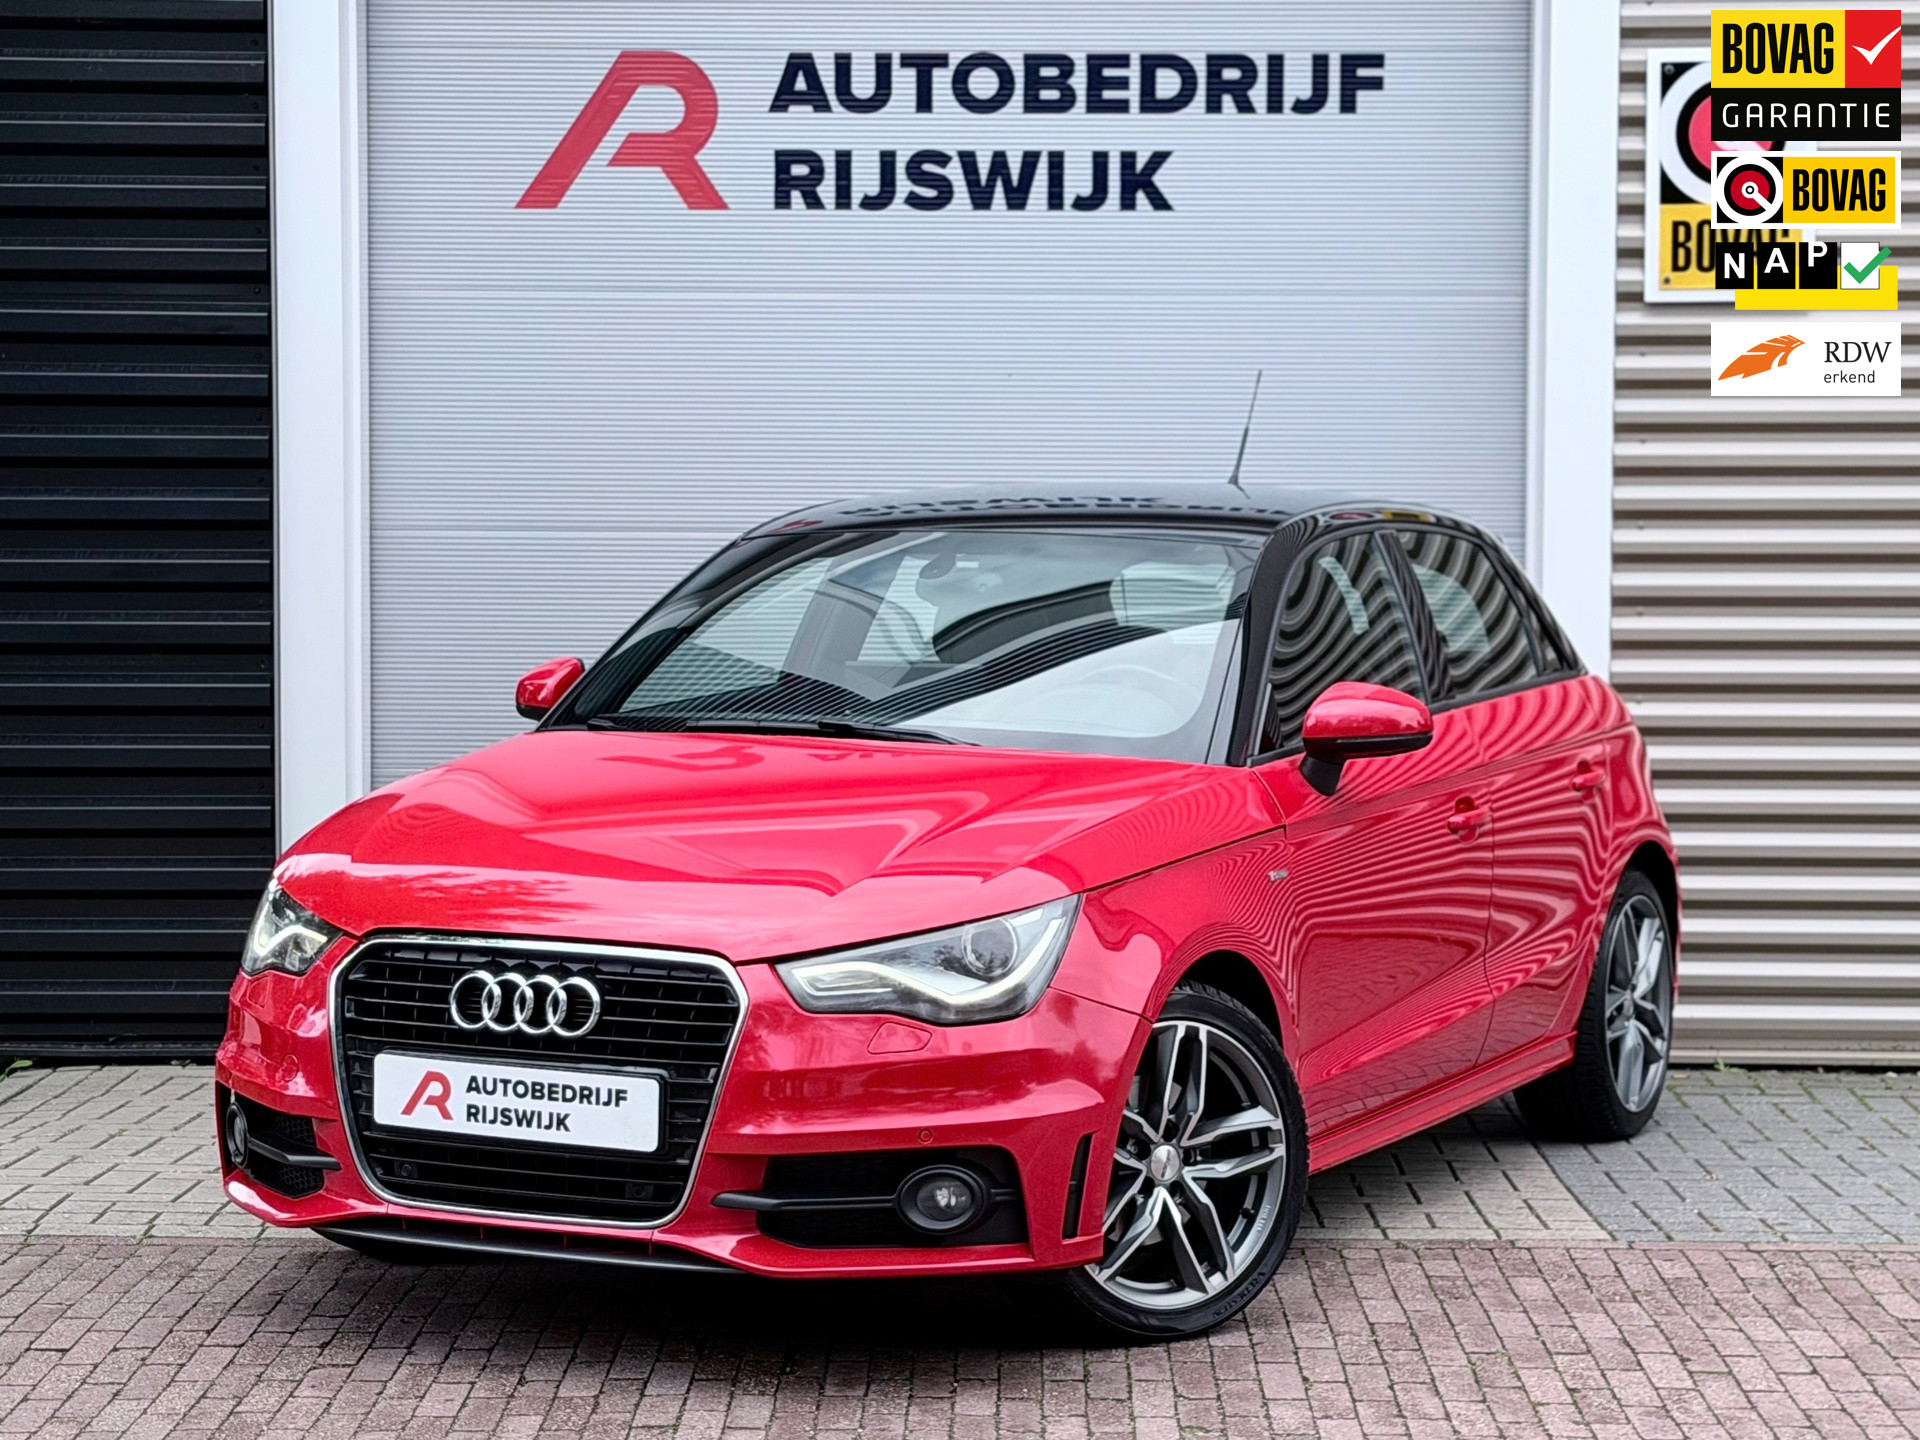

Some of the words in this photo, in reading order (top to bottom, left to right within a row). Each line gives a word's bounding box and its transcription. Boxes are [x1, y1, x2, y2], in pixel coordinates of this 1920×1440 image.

[769, 52, 1384, 115] AUTOBEDRIJF
[773, 149, 1173, 212] RIJSWIJK
[466, 1075, 628, 1108] AUTOBEDRIJF
[466, 1104, 571, 1133] RIJSWIJK
